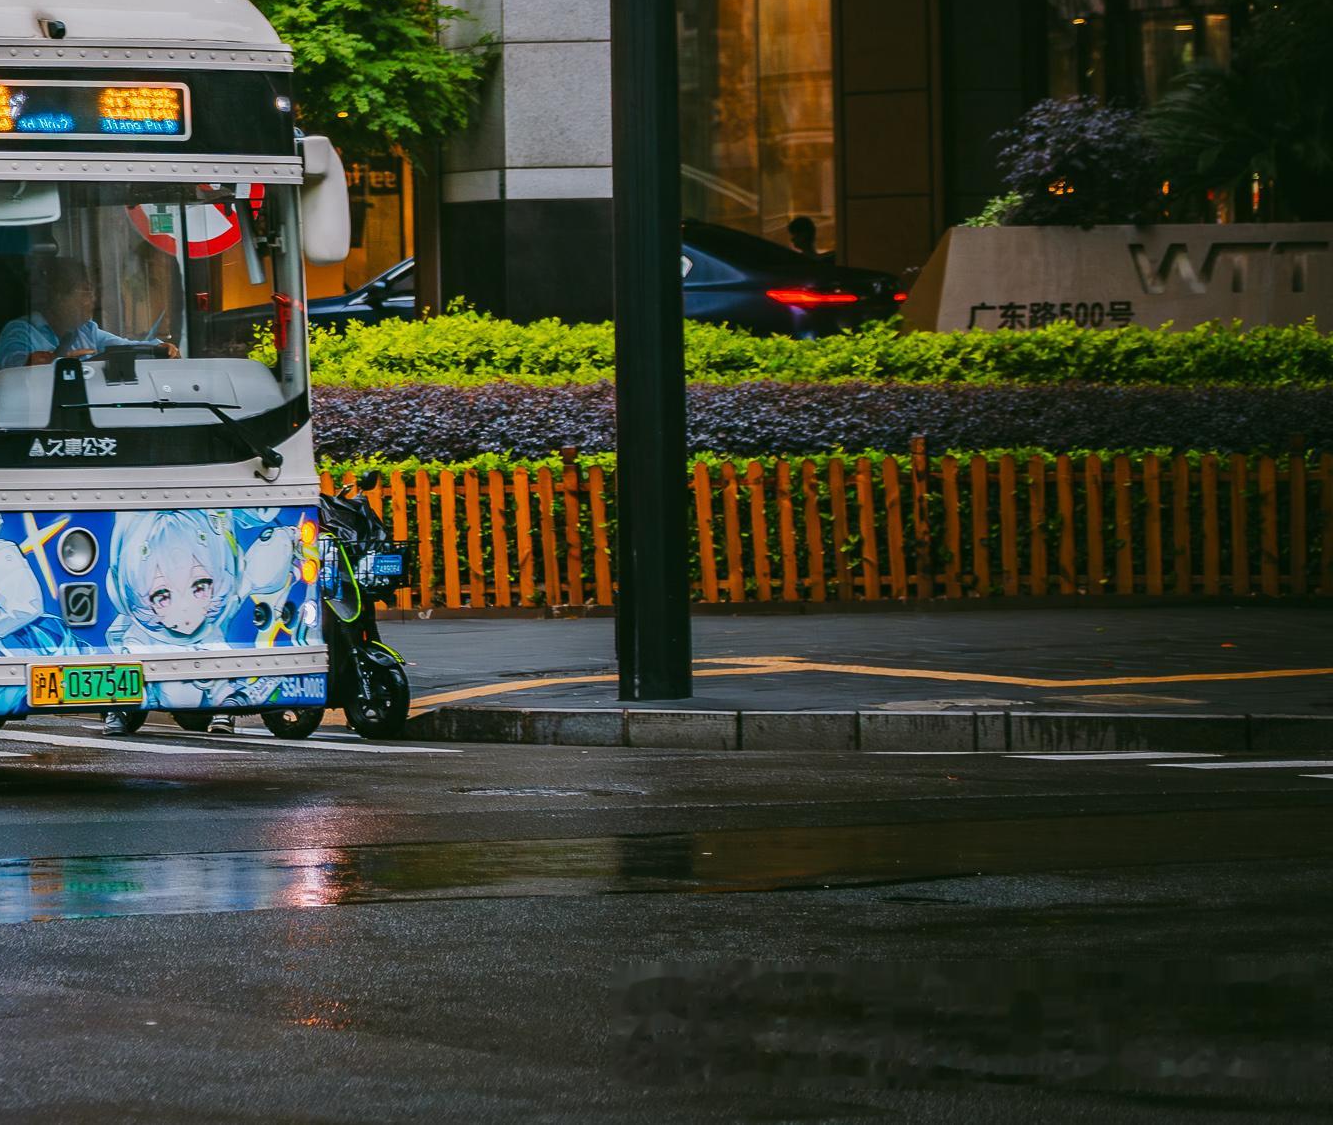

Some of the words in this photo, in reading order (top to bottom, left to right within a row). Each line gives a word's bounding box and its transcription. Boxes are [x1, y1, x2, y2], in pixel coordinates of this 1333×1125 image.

[46, 437, 117, 457] 久事公交
[35, 671, 59, 699] 沪A
[68, 669, 141, 698] 03754D
